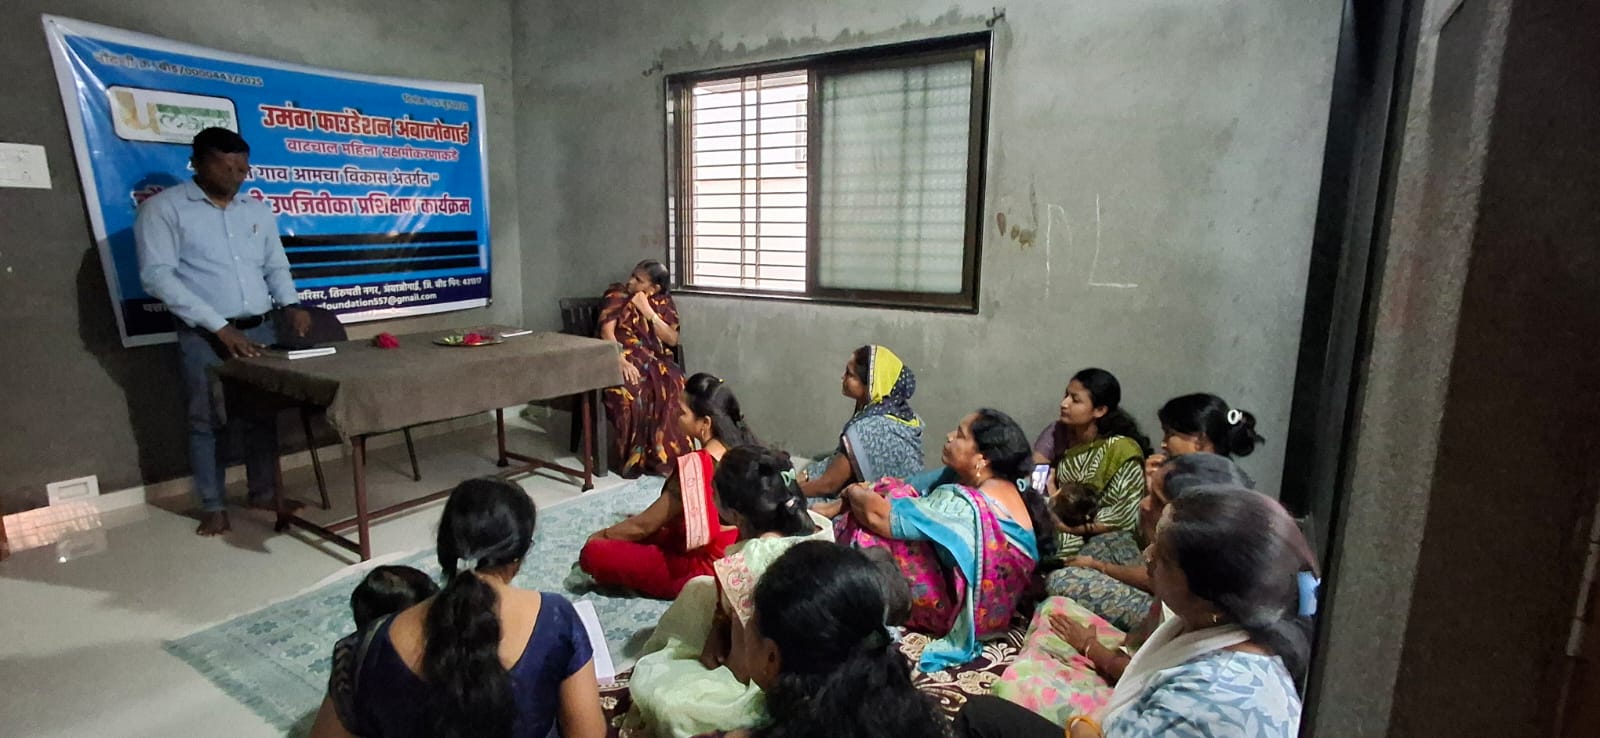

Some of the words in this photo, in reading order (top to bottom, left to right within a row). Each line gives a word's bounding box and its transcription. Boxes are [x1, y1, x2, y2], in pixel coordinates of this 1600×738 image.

[259, 101, 313, 130] उमंग
[315, 107, 392, 137] फाउंडेशन
[395, 114, 469, 145] अंबाजोगाई
[285, 138, 338, 154] वाटचाल
[340, 140, 379, 157] महिला
[257, 166, 288, 181] गाव
[293, 166, 340, 183] आमचा
[343, 165, 388, 184] विकास
[391, 168, 430, 186] अंतर्गत
[267, 190, 354, 216] उपजिवीका
[356, 192, 417, 215] प्रशिक्षण
[420, 192, 471, 215] कार्यक्रम
